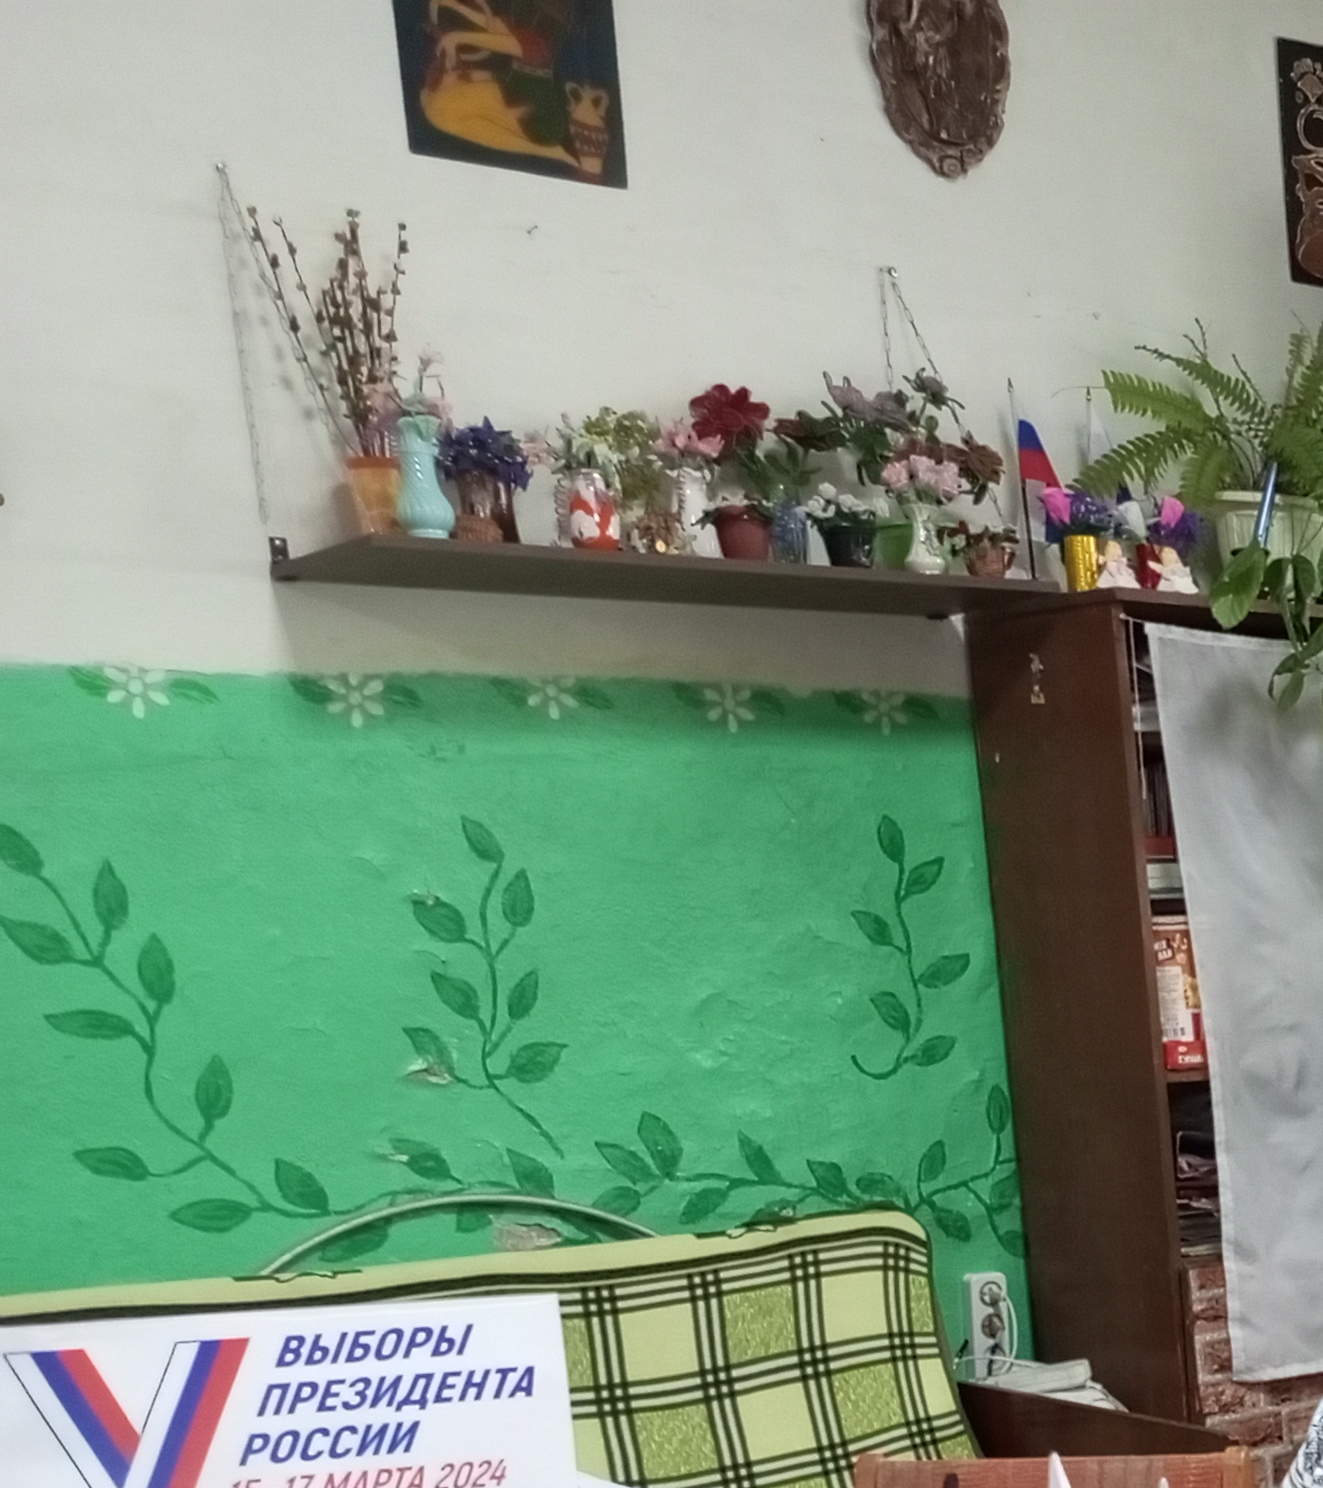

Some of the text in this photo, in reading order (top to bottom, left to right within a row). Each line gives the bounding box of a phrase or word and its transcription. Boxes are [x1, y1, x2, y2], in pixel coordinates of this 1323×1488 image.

[275, 1324, 474, 1368] ВЫБОРЫ
[256, 1366, 536, 1417] ПРЕЗИДЕНТА
[239, 1420, 421, 1466] РОССИИ
